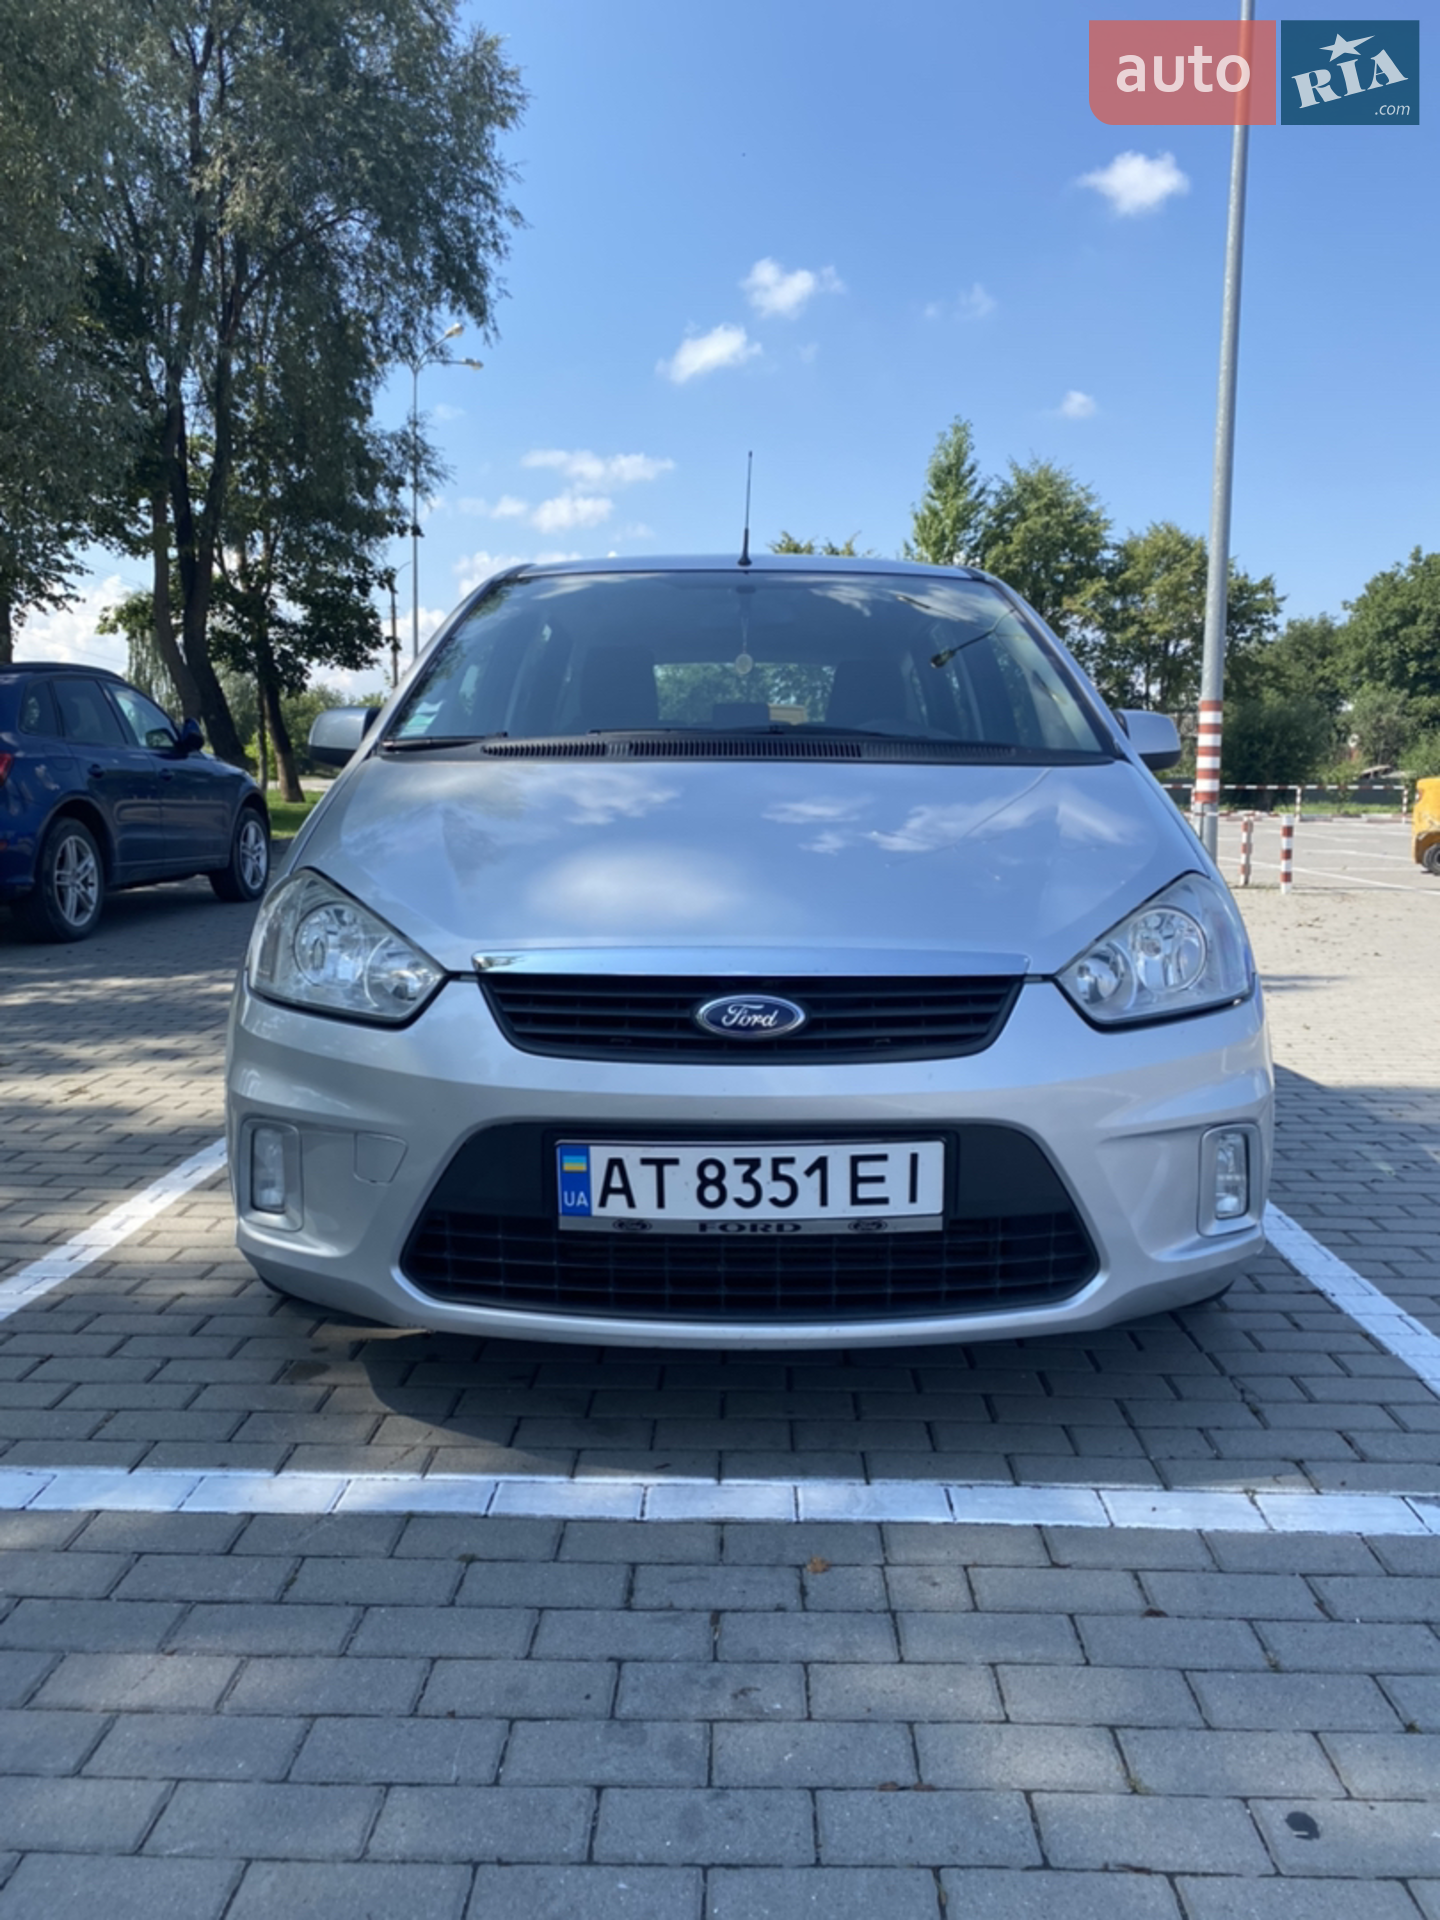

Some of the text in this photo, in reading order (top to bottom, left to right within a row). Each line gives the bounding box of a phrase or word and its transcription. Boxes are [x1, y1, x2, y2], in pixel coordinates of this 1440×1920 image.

[721, 1003, 779, 1027] Ford
[597, 1152, 919, 1210] AT 8351 EI
[563, 1191, 589, 1207] UA
[699, 1221, 802, 1233] FORD
